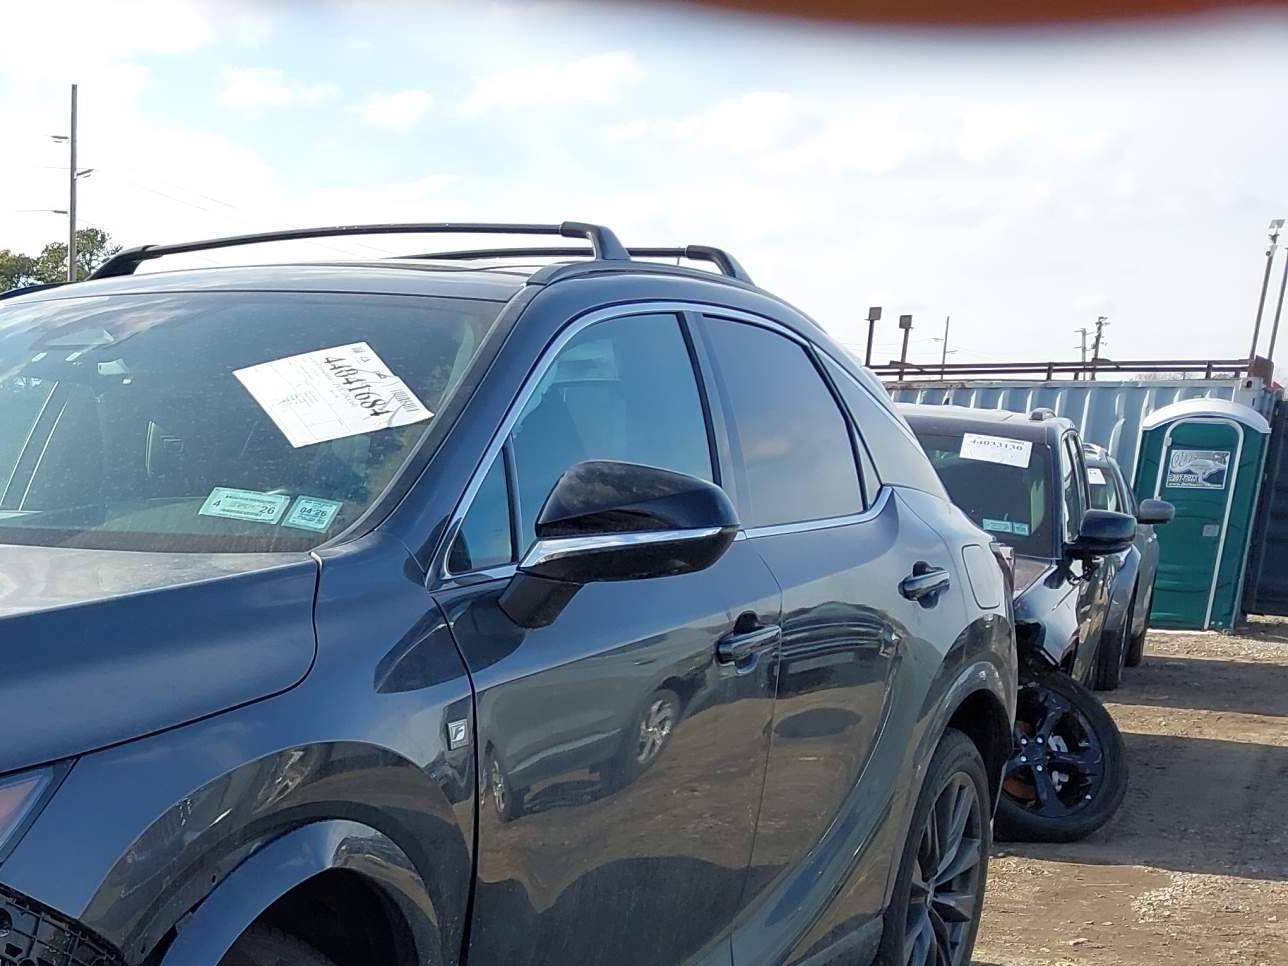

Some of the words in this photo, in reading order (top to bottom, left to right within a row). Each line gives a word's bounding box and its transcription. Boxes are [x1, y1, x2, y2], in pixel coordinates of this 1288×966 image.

[323, 356, 393, 417] 44041684
[259, 505, 275, 516] 26
[314, 510, 328, 518] 26
